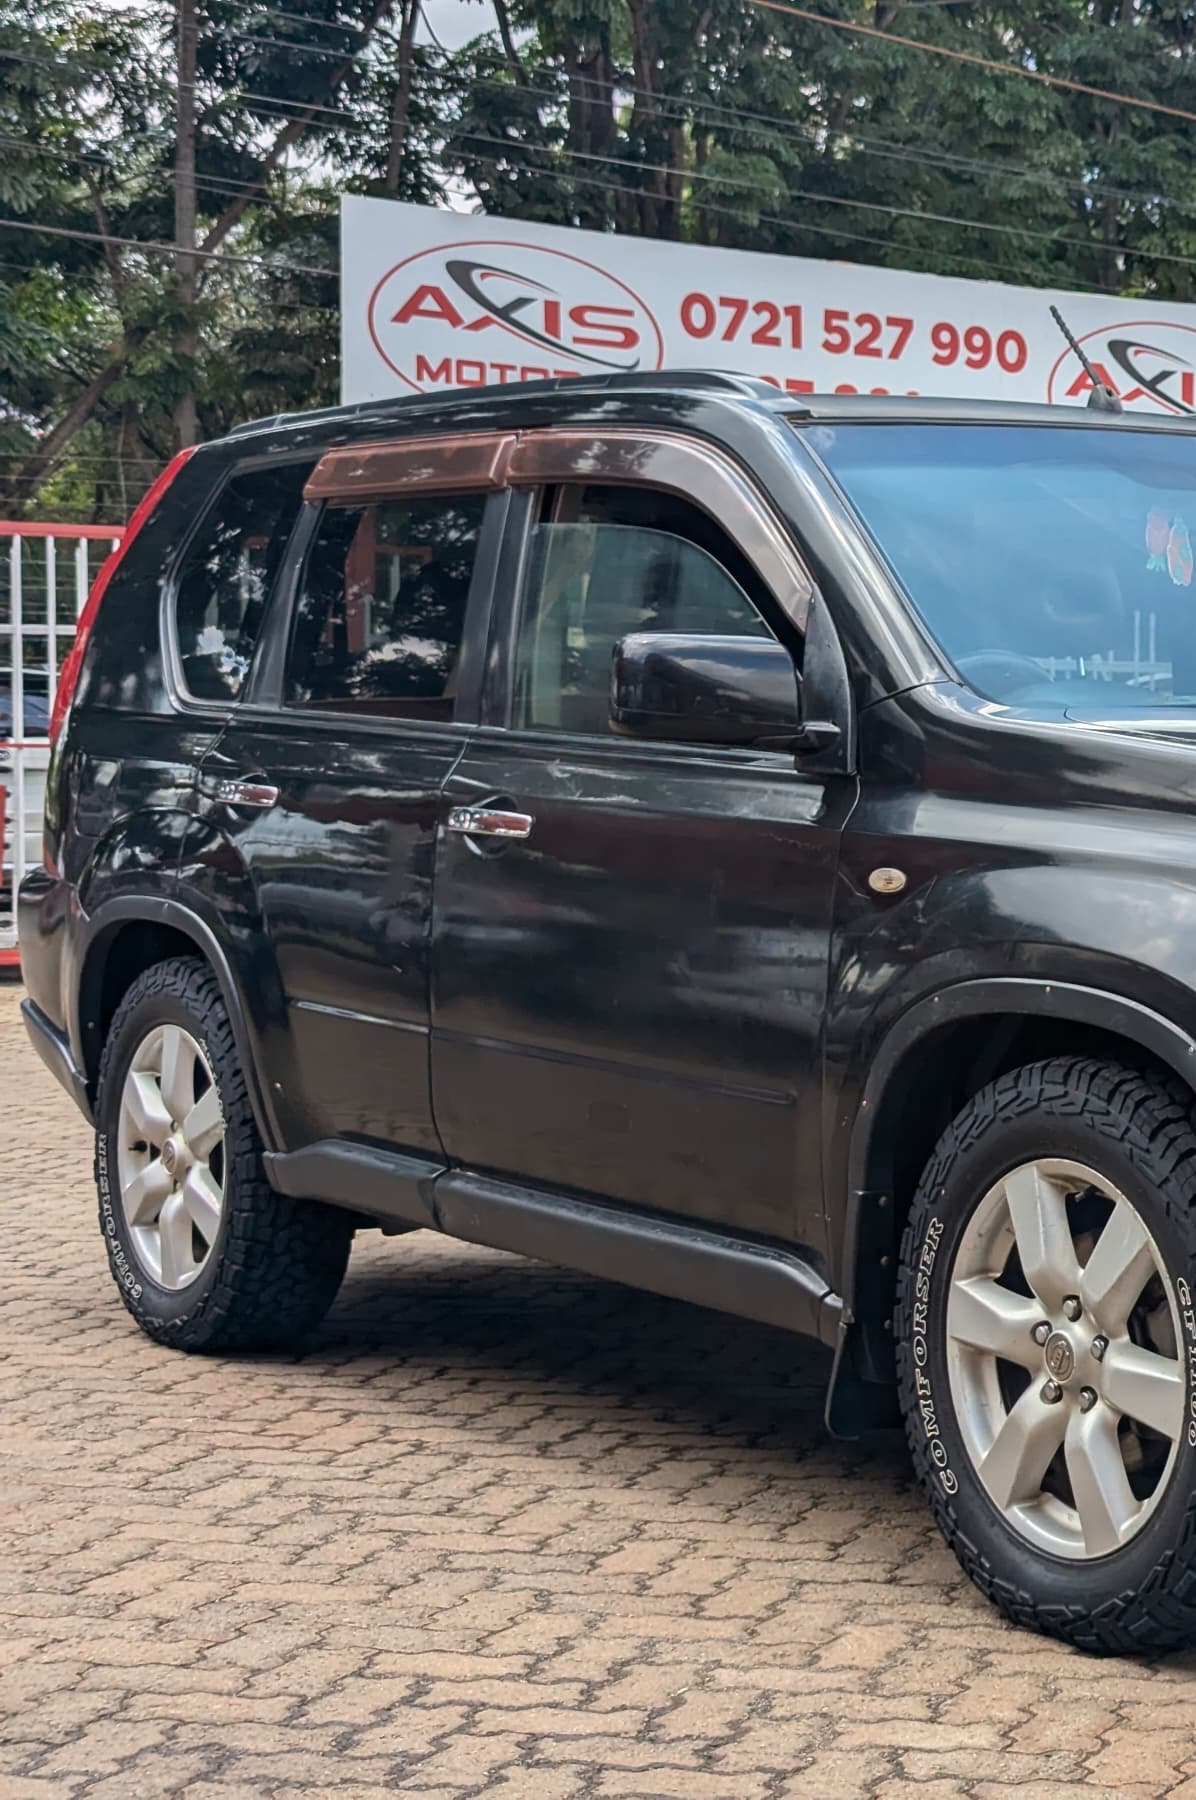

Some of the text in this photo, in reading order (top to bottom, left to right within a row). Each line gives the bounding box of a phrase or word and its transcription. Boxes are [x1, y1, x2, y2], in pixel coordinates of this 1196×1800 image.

[391, 260, 640, 358] AXIS
[680, 292, 1028, 374] 0721 527 990
[913, 1217, 959, 1494] COMFORSER
